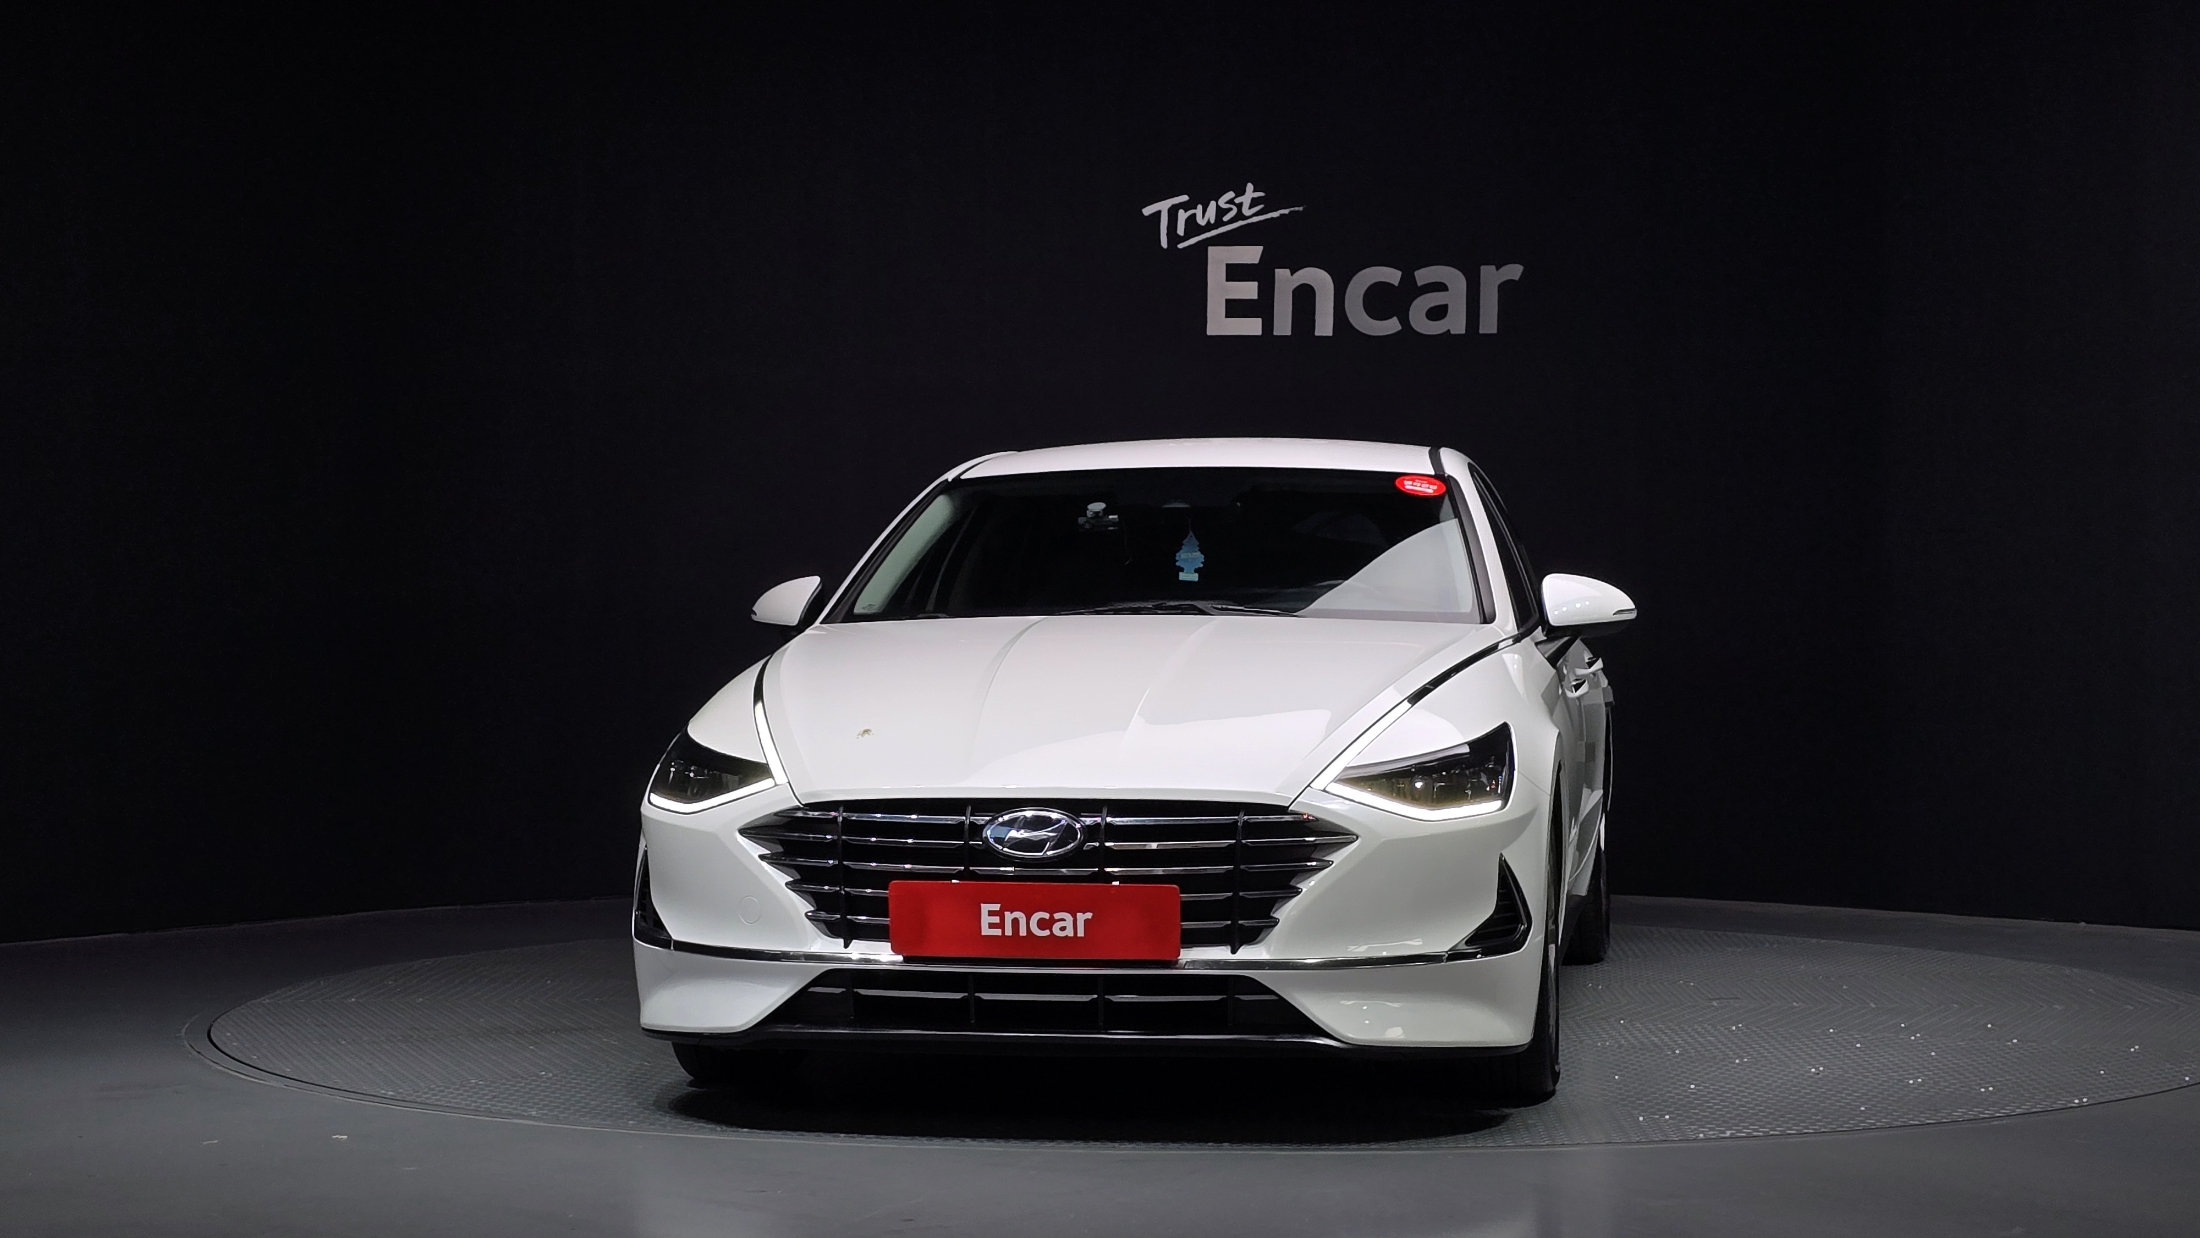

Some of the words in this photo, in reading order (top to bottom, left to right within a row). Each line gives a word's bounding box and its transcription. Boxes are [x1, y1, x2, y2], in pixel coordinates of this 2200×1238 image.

[1142, 182, 1266, 249] Trust
[1206, 245, 1525, 337] Encar
[980, 903, 1093, 937] Encar
